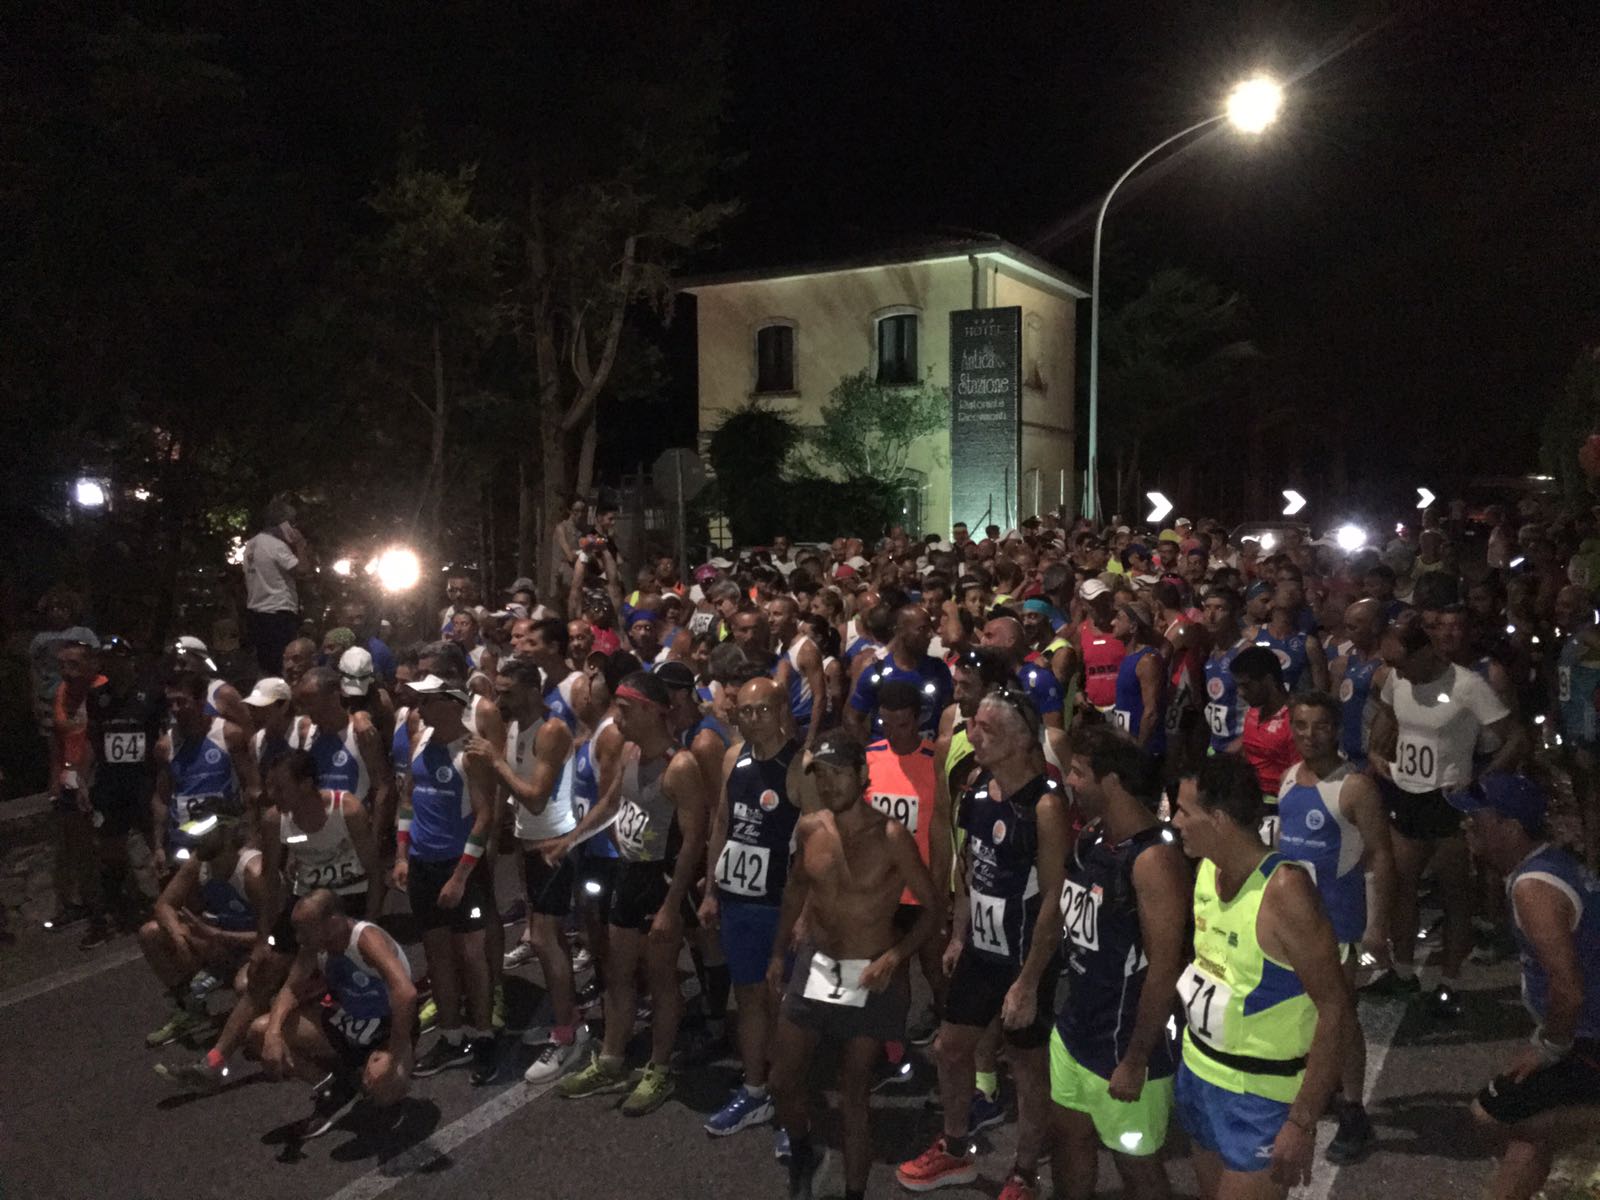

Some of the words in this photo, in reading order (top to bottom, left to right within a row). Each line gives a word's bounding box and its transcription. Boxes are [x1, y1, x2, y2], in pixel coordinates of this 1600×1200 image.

[965, 325, 1002, 337] HOTEL
[958, 372, 1009, 395] Stazione
[112, 736, 139, 760] 64
[1398, 741, 1434, 778] 130
[619, 800, 646, 844] 232
[307, 862, 353, 889] 225
[720, 848, 763, 892] 142
[974, 901, 1001, 947] 41
[1187, 974, 1217, 1039] 71
